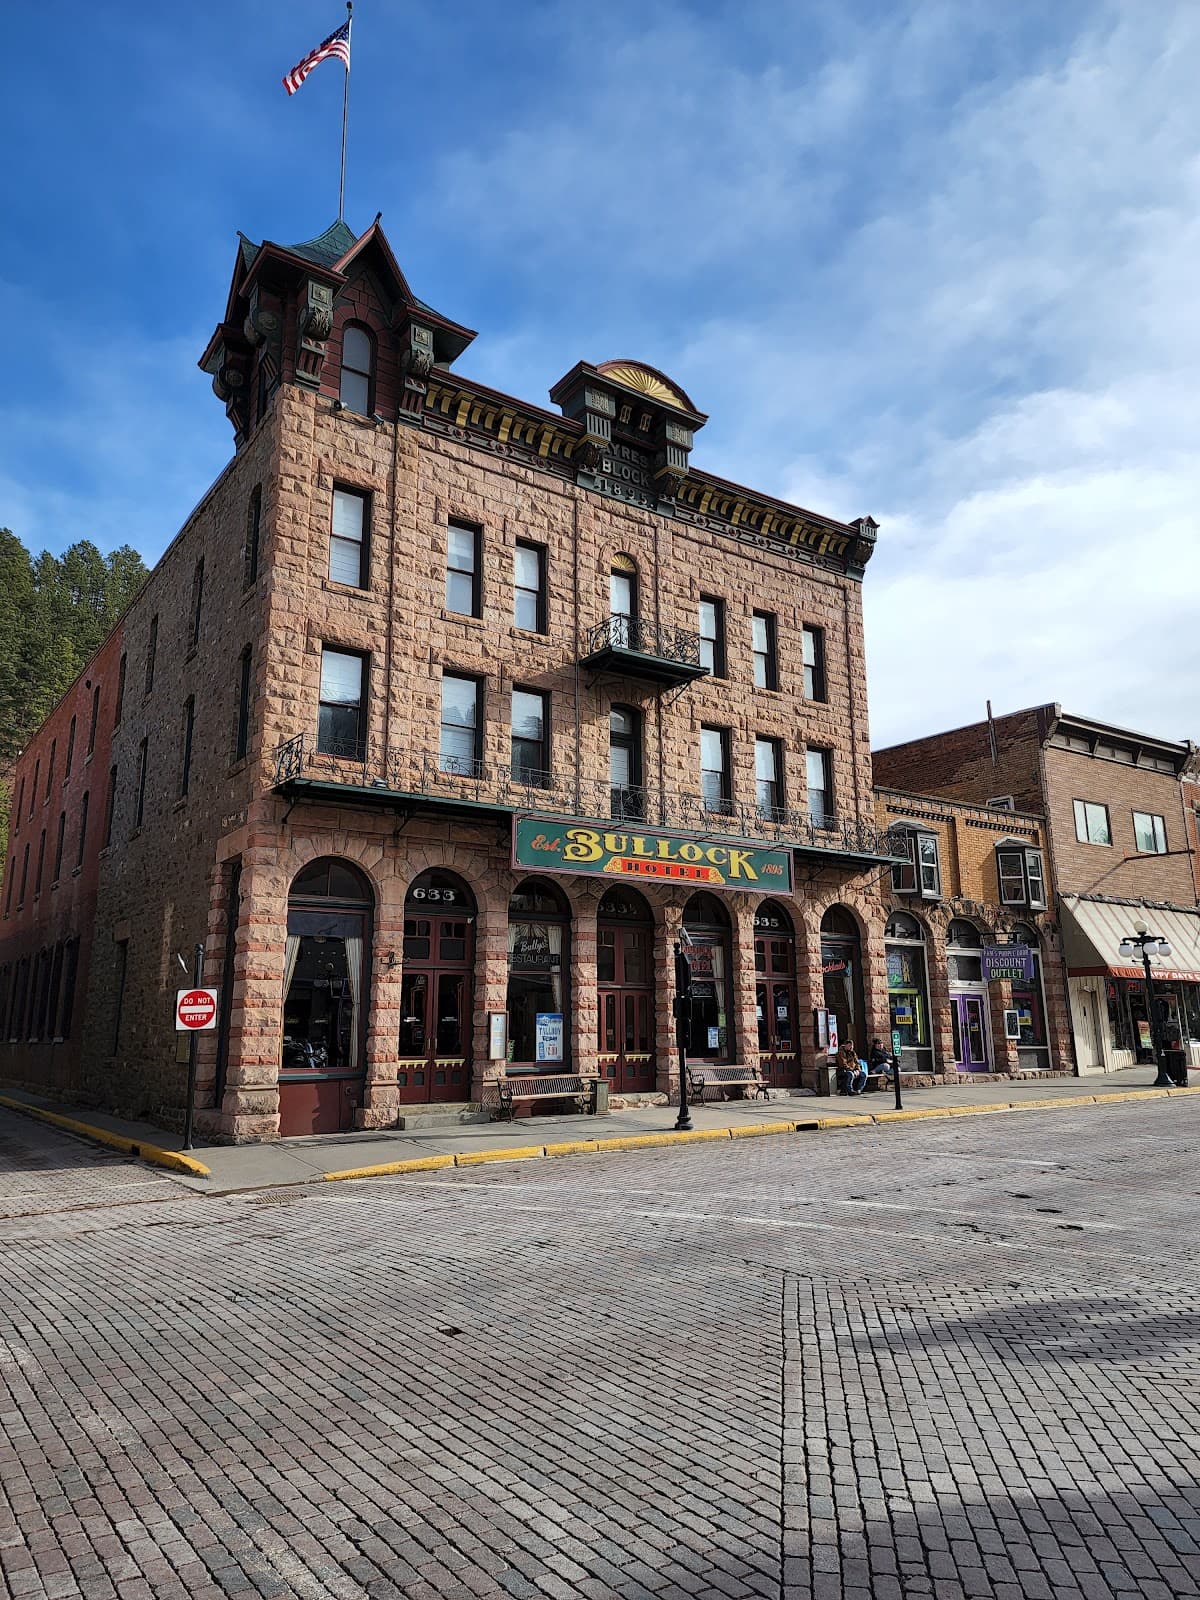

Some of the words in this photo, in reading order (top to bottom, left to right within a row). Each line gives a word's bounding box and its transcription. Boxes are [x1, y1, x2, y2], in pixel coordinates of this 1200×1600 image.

[602, 457, 650, 488] BLOCK
[530, 834, 562, 852] Est.
[561, 828, 759, 880] BULLOCK
[625, 861, 708, 879] HOTEL
[412, 887, 456, 901] 633
[508, 952, 561, 965] ESTAURANT
[985, 957, 1027, 968] DISCOUNT
[822, 959, 846, 974] ocktails
[990, 968, 1024, 979] OUTLET
[185, 1014, 207, 1022] ENTER
